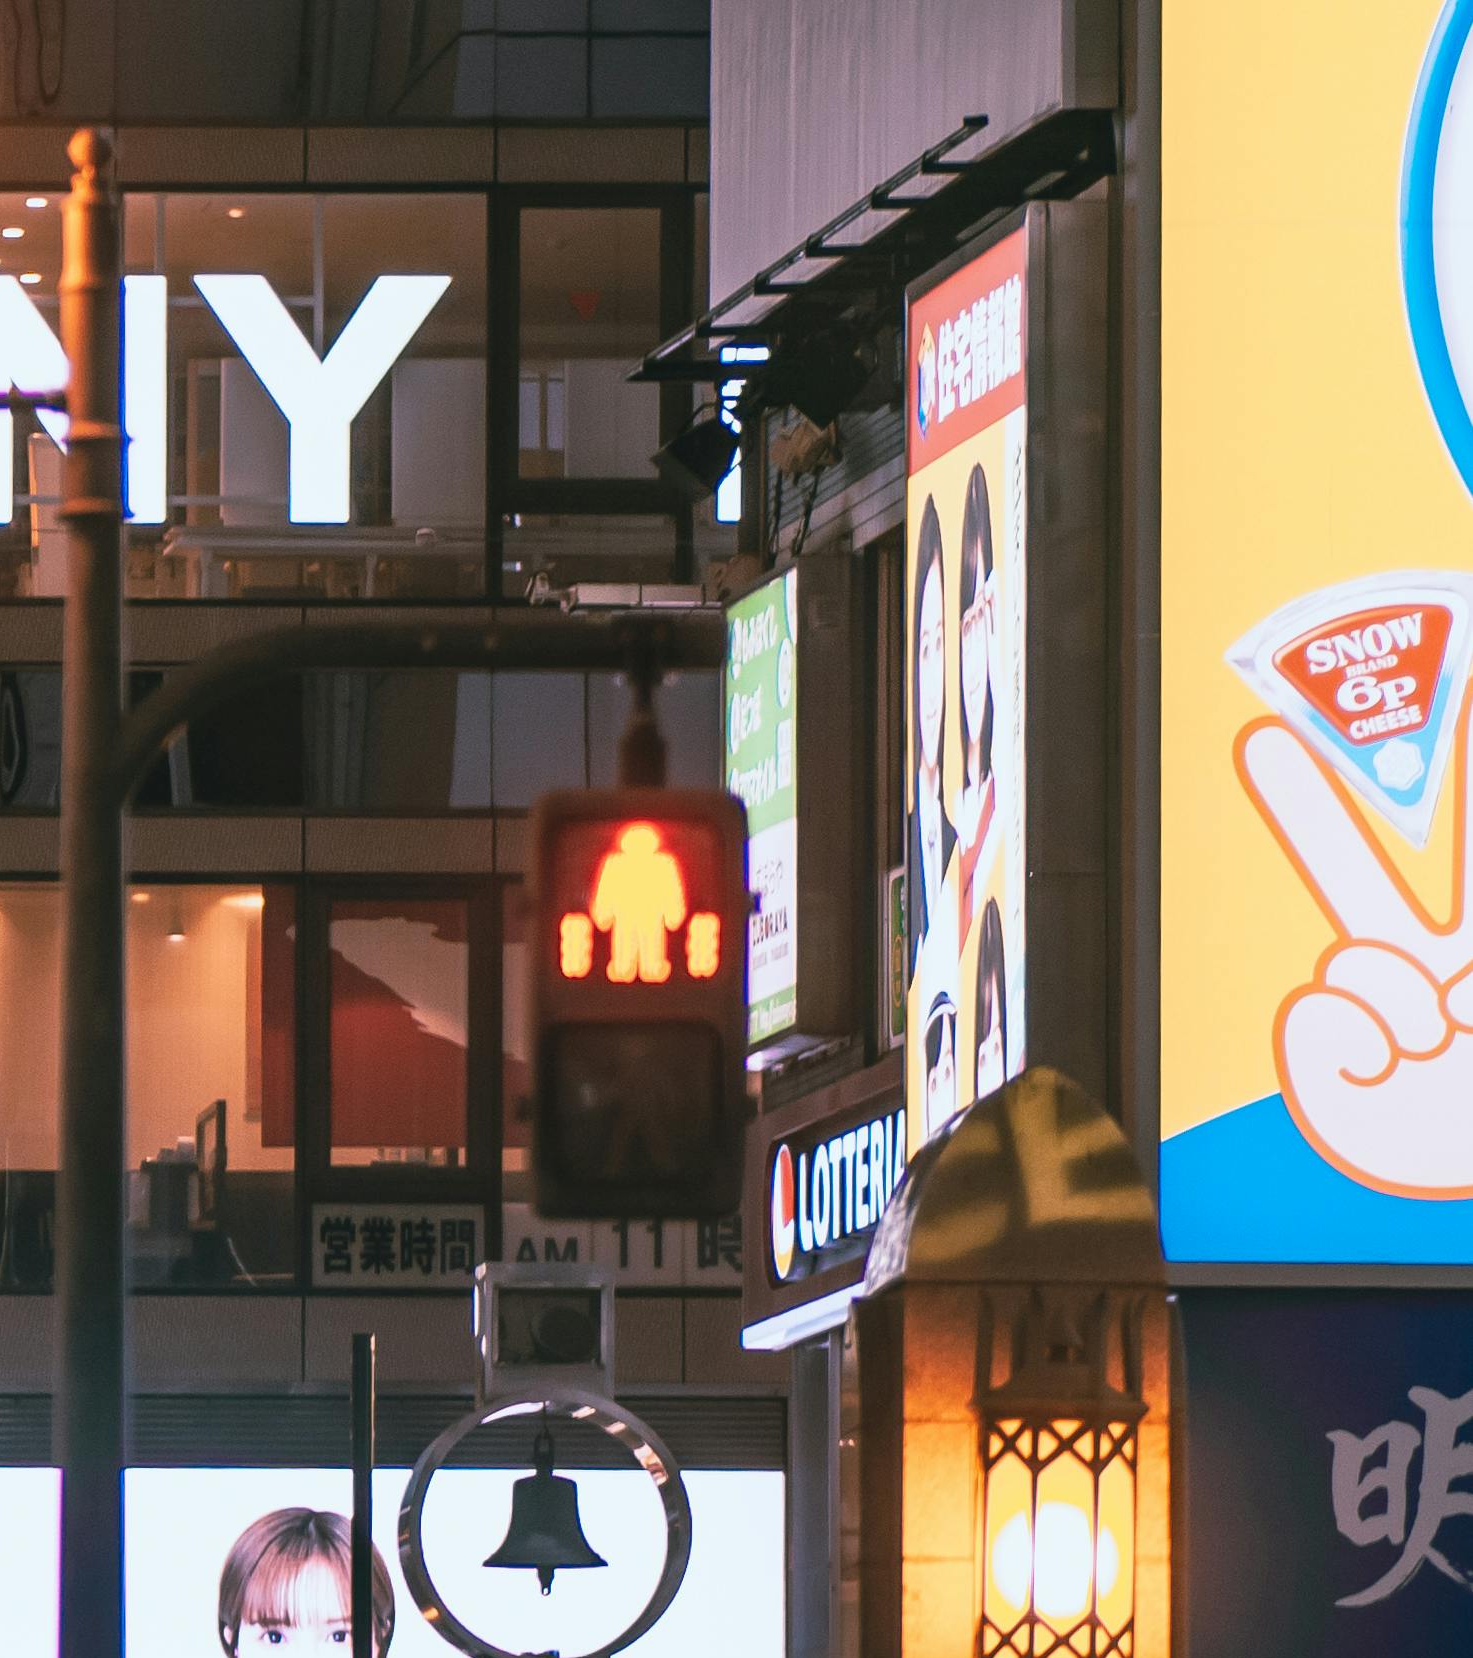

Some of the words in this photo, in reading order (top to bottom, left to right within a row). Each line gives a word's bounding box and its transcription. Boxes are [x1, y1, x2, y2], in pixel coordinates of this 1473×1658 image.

[1306, 611, 1423, 675] SNOW
[1345, 654, 1399, 678] BRAND
[1336, 675, 1417, 712] 6P
[1349, 704, 1423, 740] CHEESE
[798, 1108, 906, 1252] LOTTERIA
[319, 1215, 476, 1276] 営業時間
